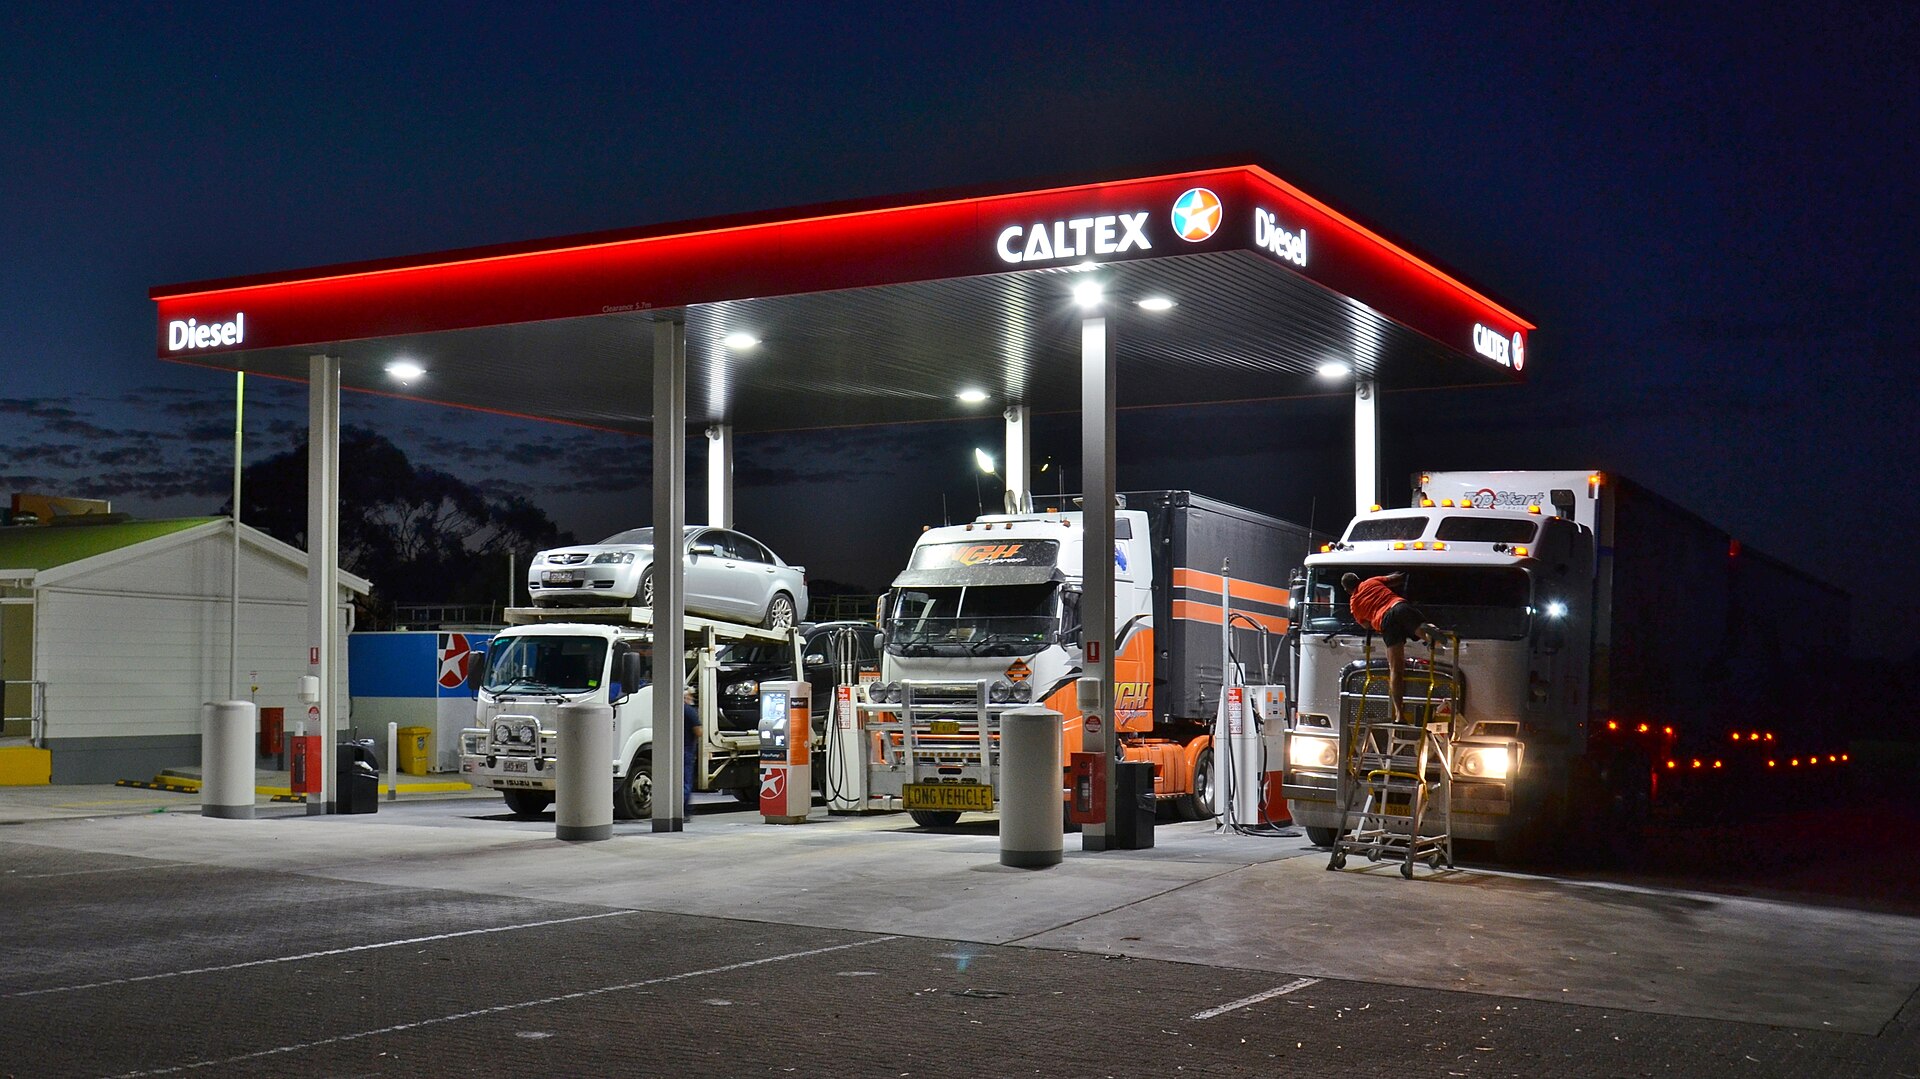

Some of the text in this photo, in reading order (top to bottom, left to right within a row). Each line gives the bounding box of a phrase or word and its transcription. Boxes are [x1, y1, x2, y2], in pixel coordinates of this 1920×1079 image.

[996, 211, 1153, 264] CALTEX
[1255, 207, 1308, 267] Diesel
[602, 304, 634, 313] Clearance
[168, 311, 245, 351] Diesel
[1473, 322, 1511, 368] CALTEX
[506, 779, 530, 787] ISUZU
[907, 786, 988, 806] LONG VEHICLE
